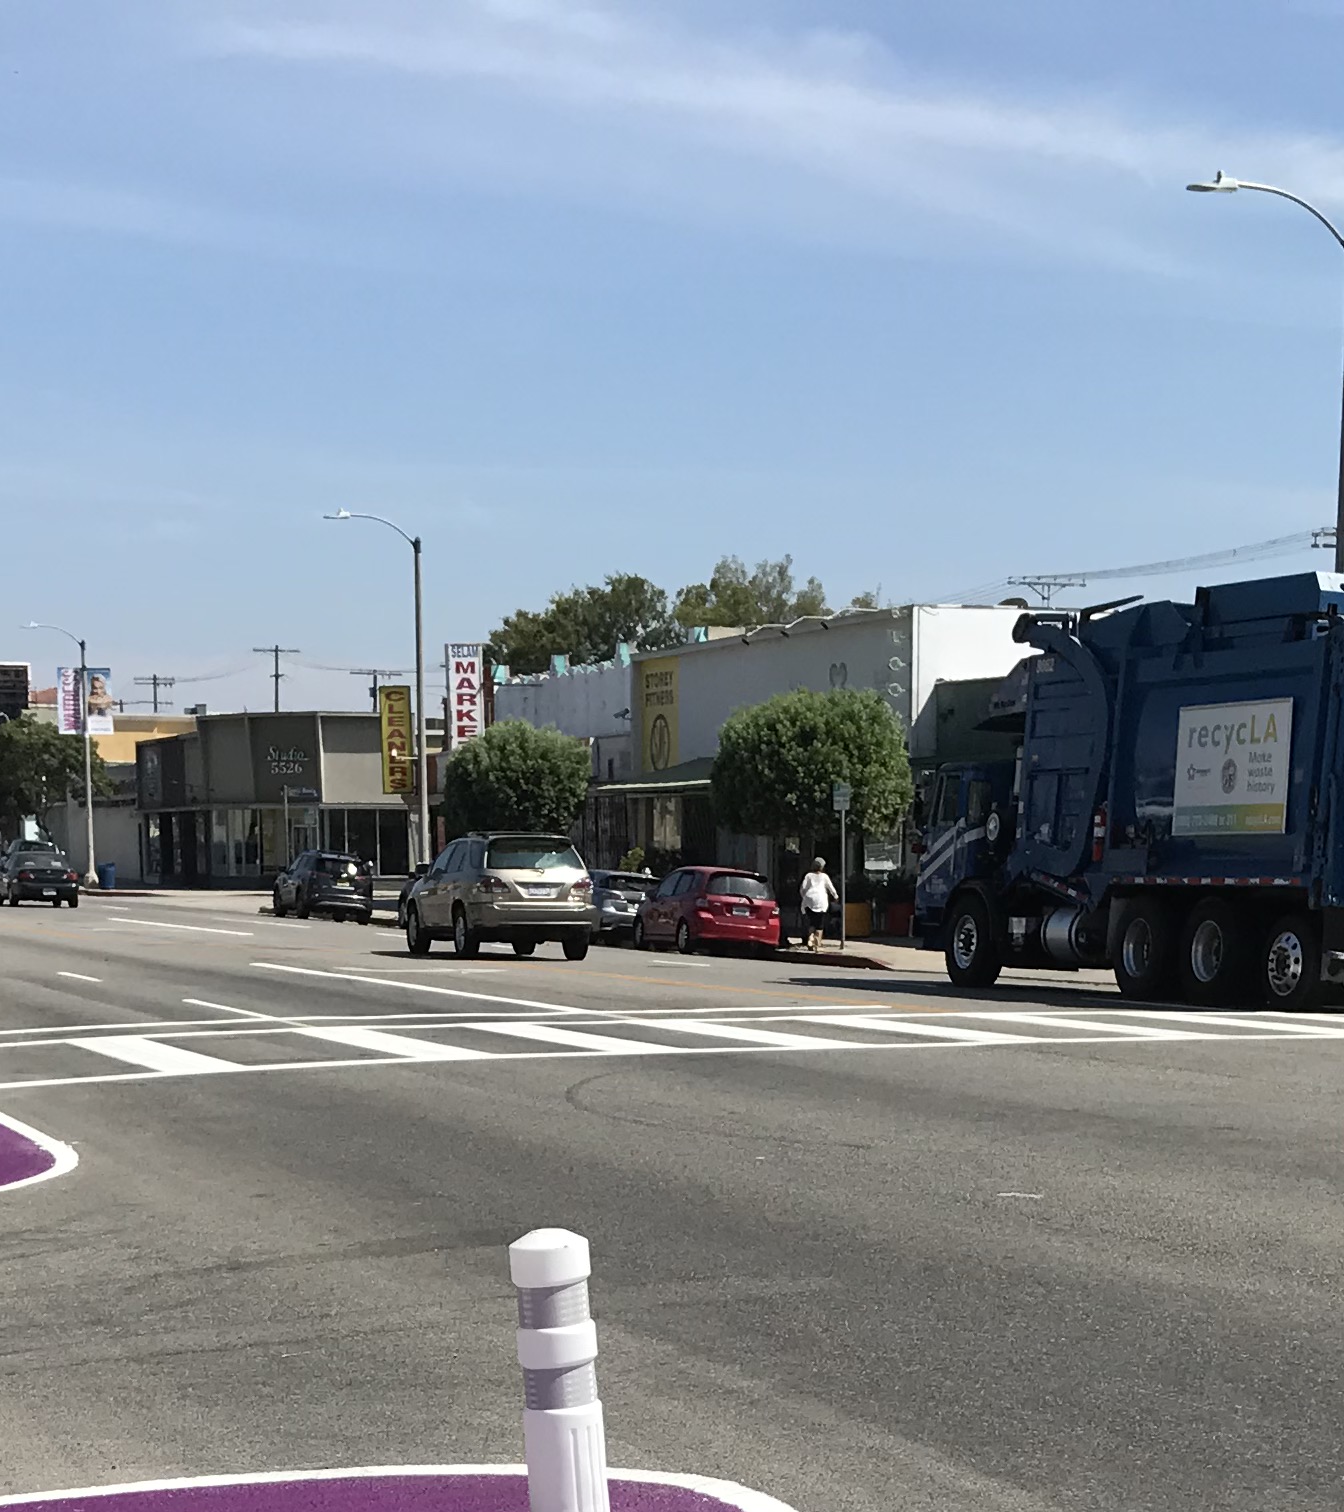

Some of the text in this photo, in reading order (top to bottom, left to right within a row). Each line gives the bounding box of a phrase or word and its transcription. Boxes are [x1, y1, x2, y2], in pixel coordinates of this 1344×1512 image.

[451, 644, 479, 658] SELAM
[645, 671, 674, 689] STOREY
[455, 661, 478, 744] MARKE
[645, 690, 674, 707] FITNESS
[385, 690, 408, 790] CLEANERS
[1187, 713, 1278, 755] recycLA
[266, 746, 310, 761] Studio
[1248, 751, 1273, 764] Make
[270, 762, 303, 774] 5526
[1247, 766, 1273, 778] waste
[1246, 780, 1275, 795] history
